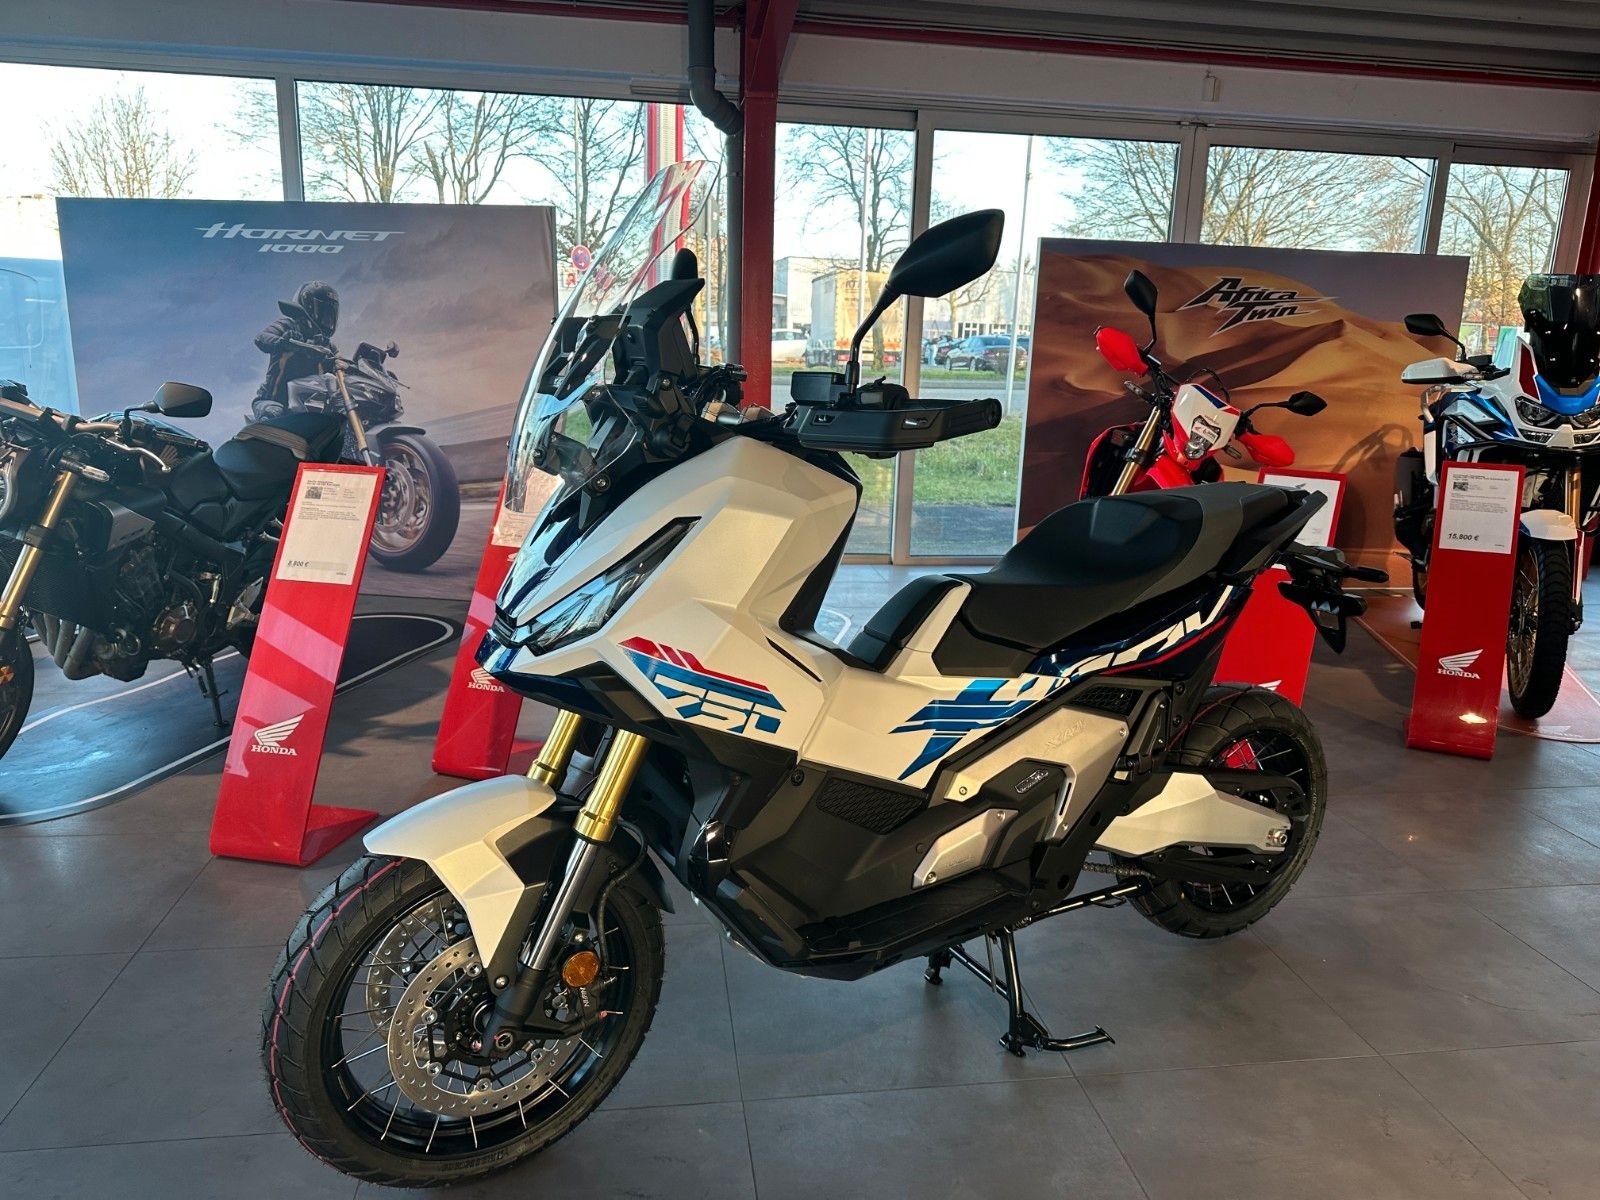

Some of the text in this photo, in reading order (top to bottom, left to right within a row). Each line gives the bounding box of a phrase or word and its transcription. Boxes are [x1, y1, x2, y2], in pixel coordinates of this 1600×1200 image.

[195, 222, 405, 241] HORNET
[258, 243, 345, 254] 1000
[1177, 276, 1322, 312] Africa
[1211, 300, 1314, 337] Twin
[1437, 668, 1481, 680] HONDA
[467, 681, 505, 693] HONDA
[250, 744, 298, 756] HONDA
